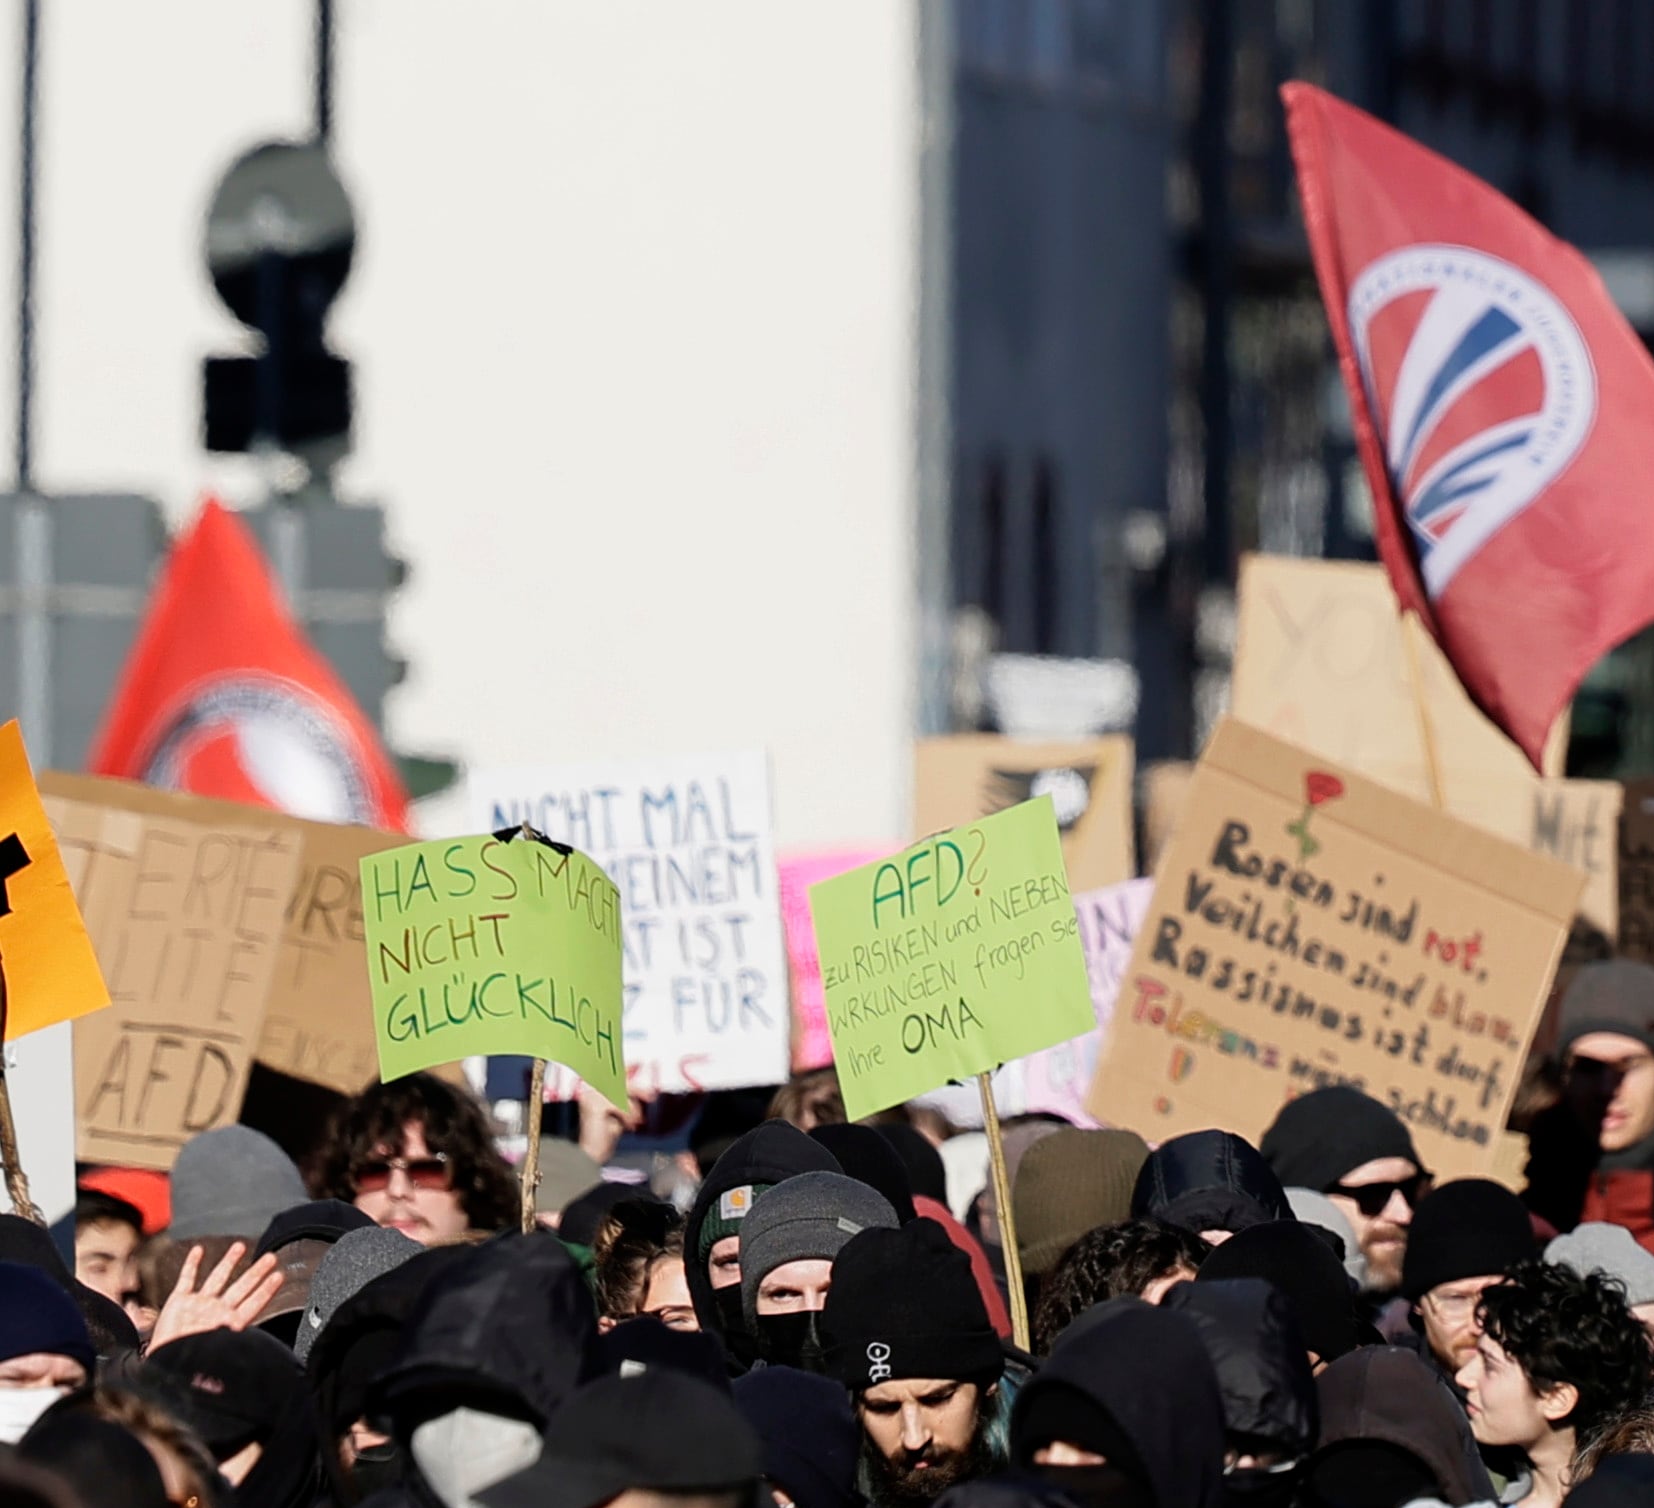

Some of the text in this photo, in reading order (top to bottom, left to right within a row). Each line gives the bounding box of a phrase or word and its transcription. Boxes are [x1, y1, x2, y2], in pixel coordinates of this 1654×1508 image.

[639, 775, 757, 849] MAL
[373, 841, 518, 922] HASS
[535, 850, 622, 953] MACHT
[608, 848, 762, 910] EINEM
[852, 920, 939, 984] RISIKEN
[946, 906, 981, 944] und
[989, 871, 1069, 925] NEBEN
[872, 828, 988, 929] AFD?
[1211, 820, 1337, 908] Rosen
[1339, 872, 1419, 946] sind
[379, 912, 511, 984] NICHT
[677, 912, 750, 970] IST
[973, 930, 1046, 990] fragen
[1050, 914, 1079, 944] Sie
[1182, 866, 1349, 974] Veilchen
[1350, 950, 1430, 1011] sind
[387, 971, 617, 1076] GLÜCKLICH
[848, 996, 984, 1079] Ihre OMA
[1148, 914, 1365, 1041] Rassismus
[1371, 1003, 1431, 1066] ist
[84, 1033, 236, 1132] AFD
[1132, 974, 1281, 1072] Toleranz
[1387, 1085, 1492, 1148] schlau
